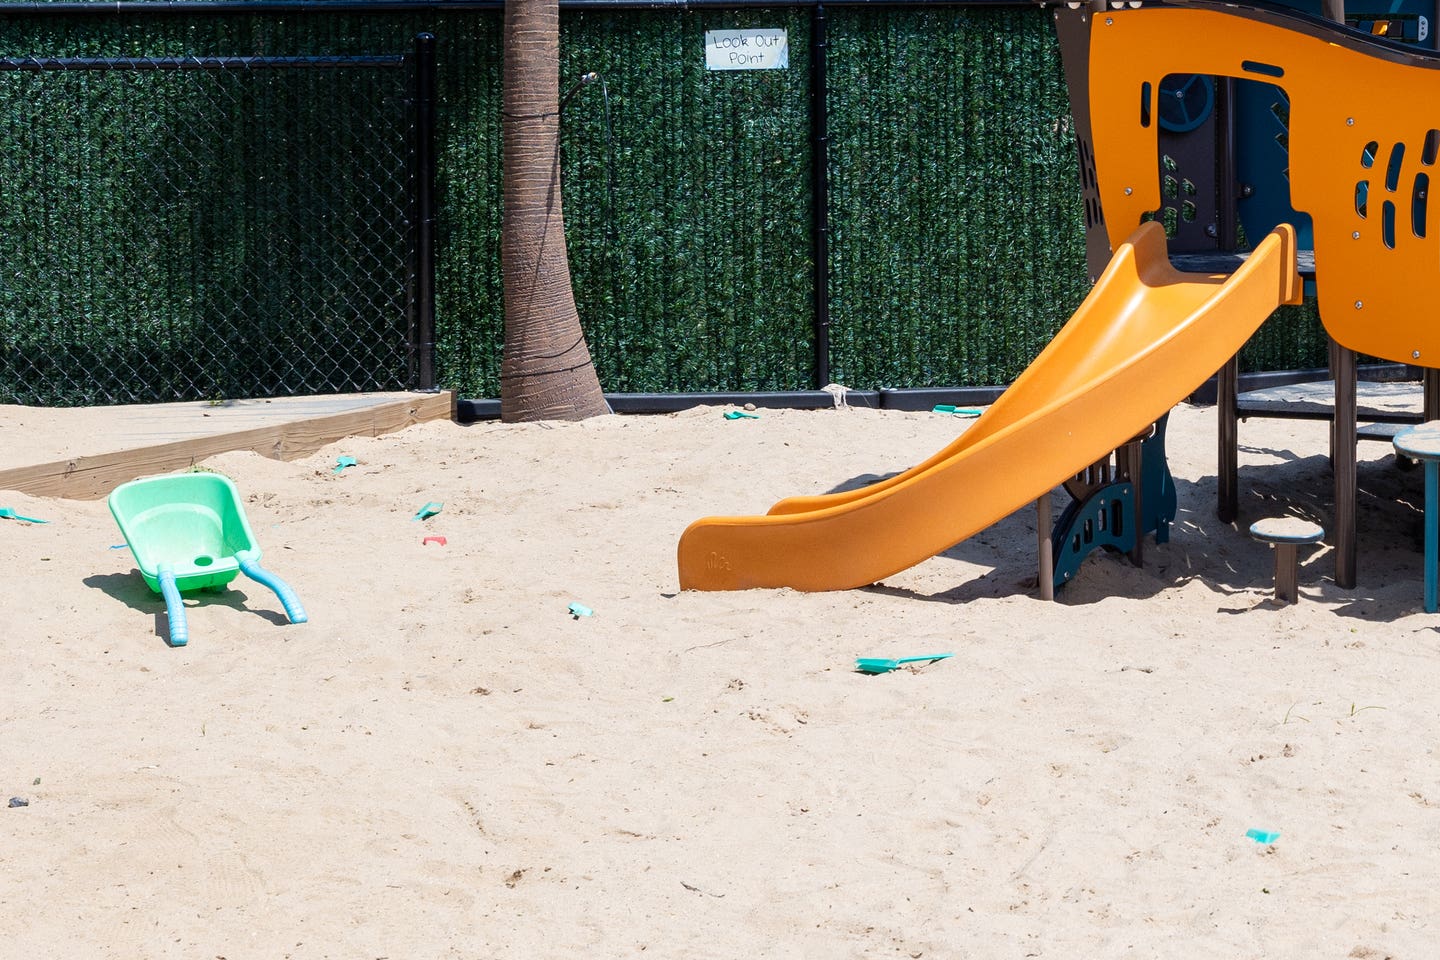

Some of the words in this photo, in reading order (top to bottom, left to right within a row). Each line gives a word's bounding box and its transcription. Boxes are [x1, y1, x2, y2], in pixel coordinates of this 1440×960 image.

[713, 34, 749, 49] Look
[755, 34, 779, 47] Out
[729, 51, 765, 65] Point
